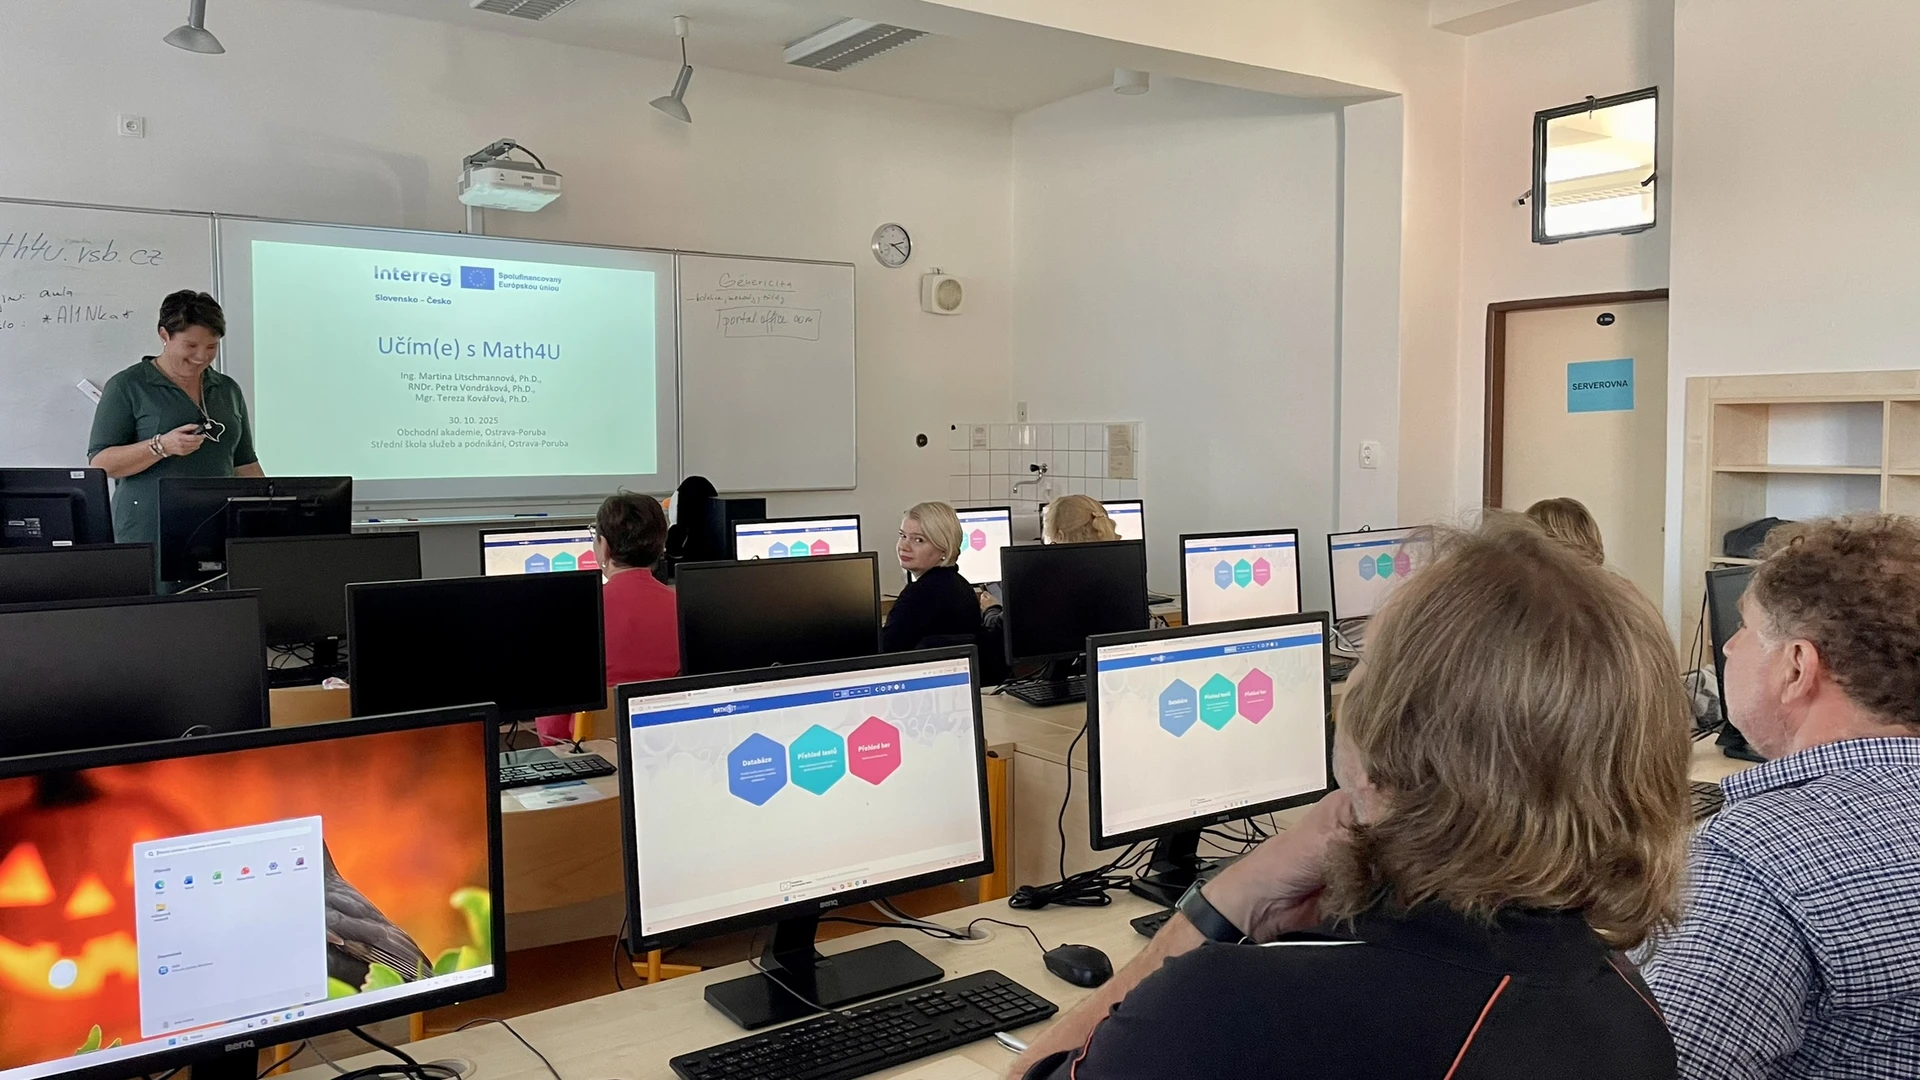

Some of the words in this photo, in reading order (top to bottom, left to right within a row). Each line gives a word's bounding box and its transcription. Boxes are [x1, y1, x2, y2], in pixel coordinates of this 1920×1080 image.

[374, 265, 452, 287] Interreg
[498, 272, 562, 284] Spolufinancovaný
[498, 281, 538, 292] Európskou
[375, 294, 418, 304] Slovensko
[426, 296, 452, 305] Česko
[378, 336, 460, 360] Učím(e)
[467, 346, 476, 358] s
[483, 341, 561, 360] Math4U
[400, 372, 416, 382] Ing.
[418, 372, 452, 380] Martina
[454, 373, 517, 383] Litschmannová,
[518, 375, 542, 383] Ph.D.,
[460, 384, 510, 393] Vondráková,
[1572, 380, 1628, 390] SERVEROVNA
[415, 394, 436, 403] Mgr.
[437, 394, 465, 402] Tereza
[467, 394, 507, 403] Kovářová,
[509, 395, 530, 403] Ph.D.
[397, 428, 438, 436] Obchodní
[440, 428, 483, 437] akademie,
[485, 428, 546, 436] Ostrava-Poruba
[371, 440, 403, 448] Střední
[405, 440, 427, 448] škola
[429, 440, 456, 448] služeb
[464, 440, 506, 449] podnikání,
[508, 440, 569, 448] Ostrava-Poruba
[858, 743, 880, 752] Přehled
[797, 750, 821, 760] Přehled
[822, 747, 837, 757] testů
[742, 756, 772, 767] Databáze
[224, 1040, 255, 1052] BenQ
